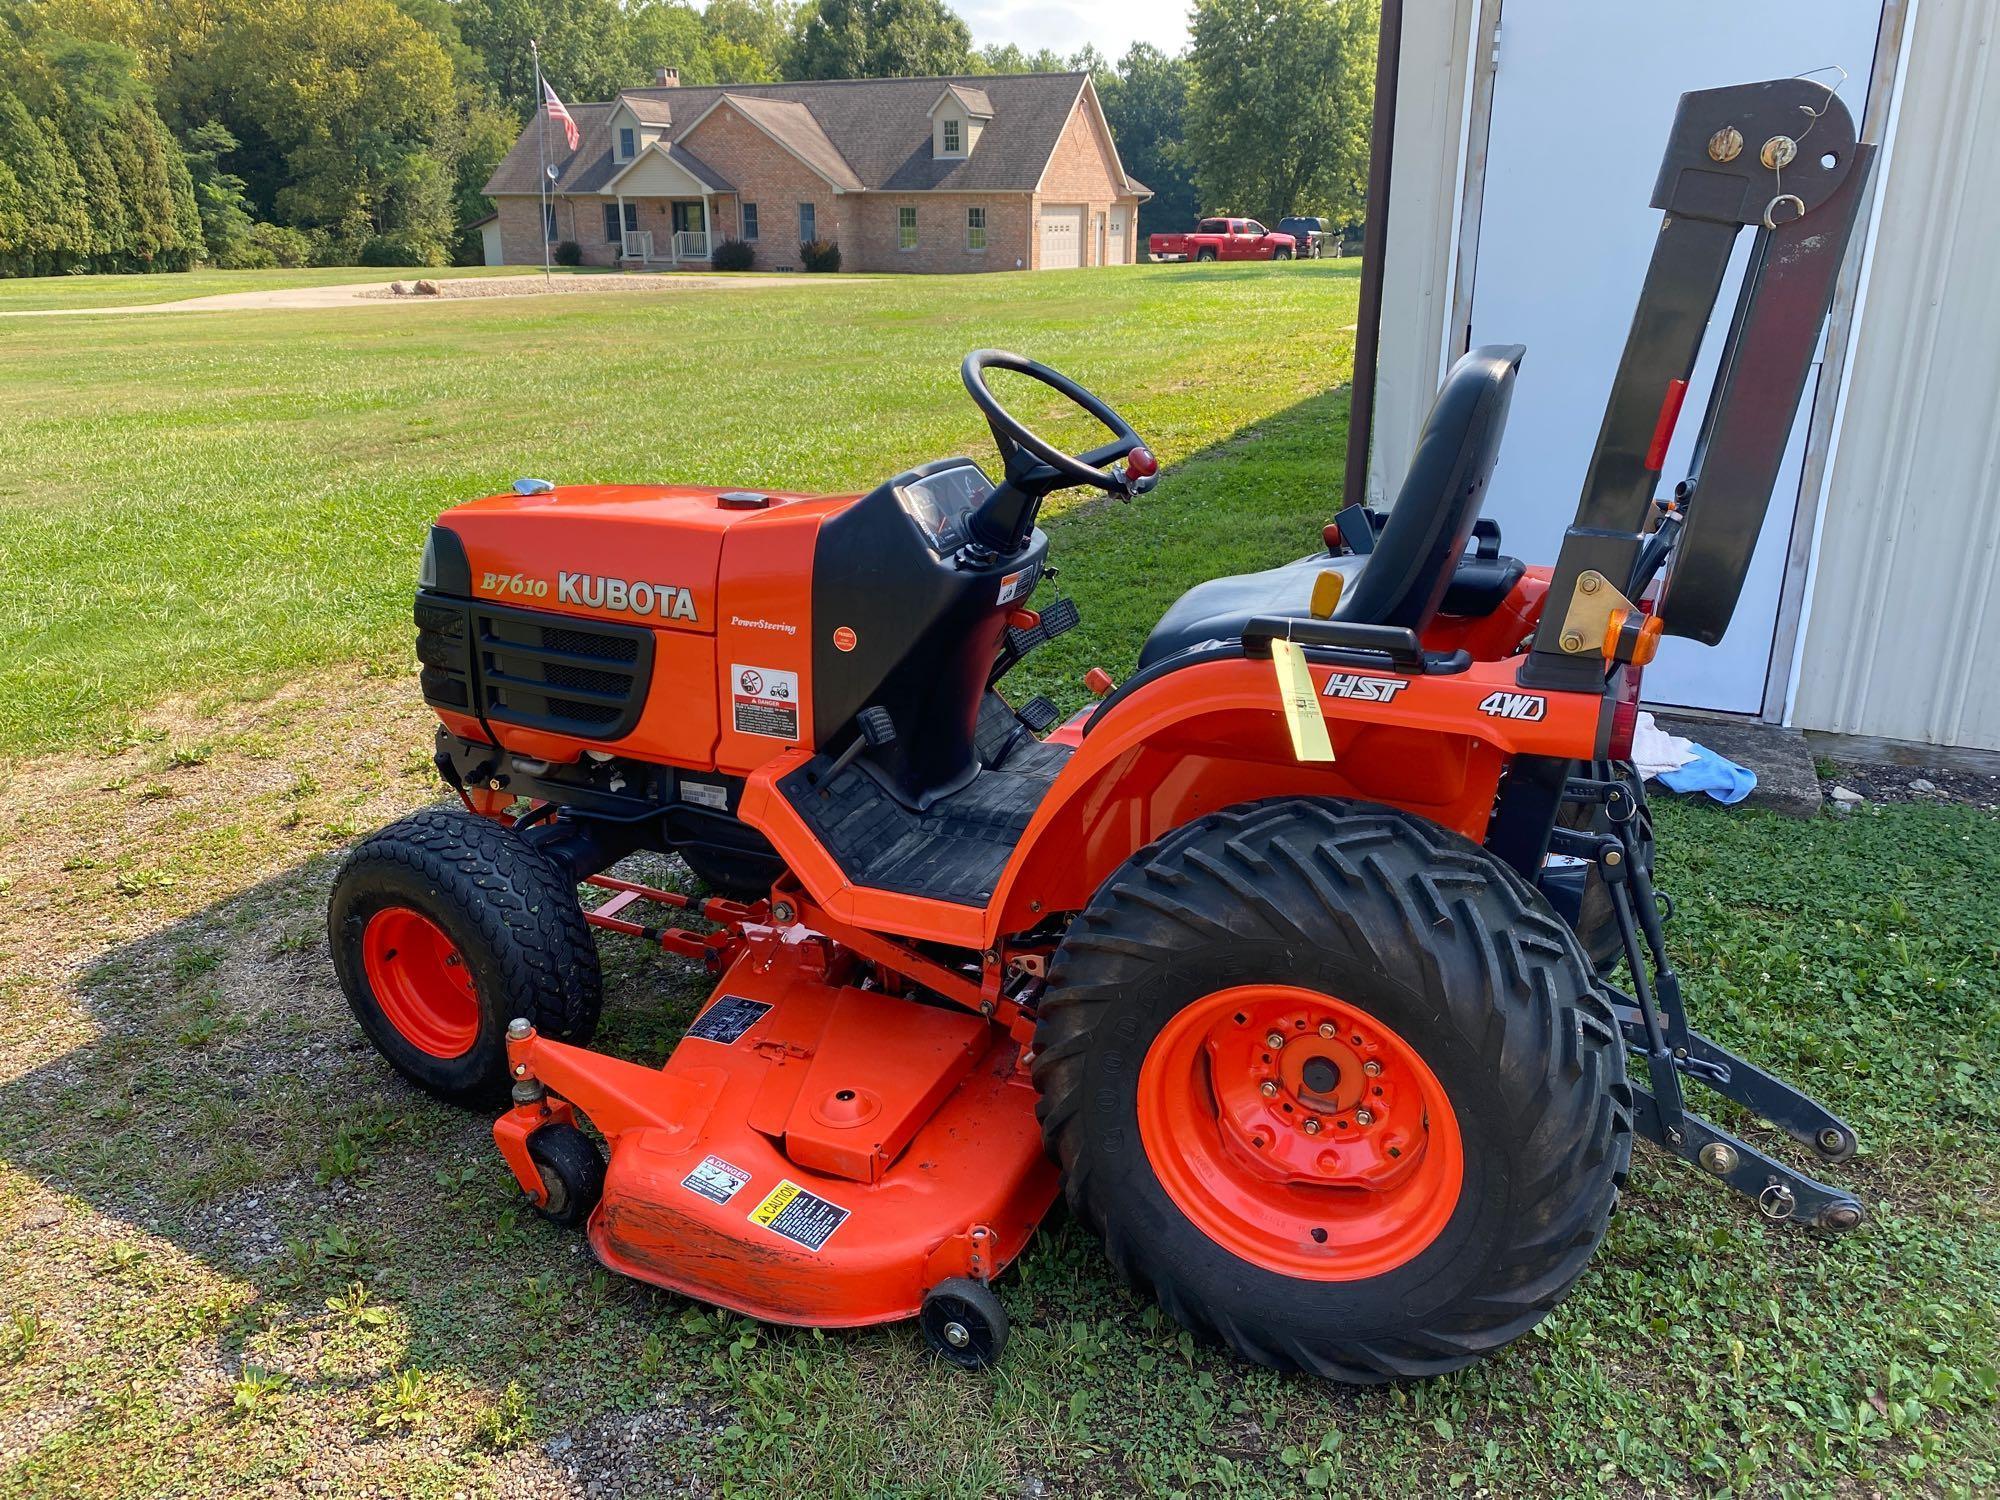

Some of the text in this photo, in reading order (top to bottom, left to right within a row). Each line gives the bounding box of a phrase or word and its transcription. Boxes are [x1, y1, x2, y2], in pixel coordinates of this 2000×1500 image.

[479, 571, 698, 622] B7610 KUBOTA
[731, 616, 797, 635] PowerSteering
[1322, 673, 1409, 702] HST
[757, 698, 780, 707] DANGER
[1479, 692, 1547, 721] 4WD
[714, 1160, 750, 1181] DANGER
[764, 1184, 797, 1214] CAUTION
